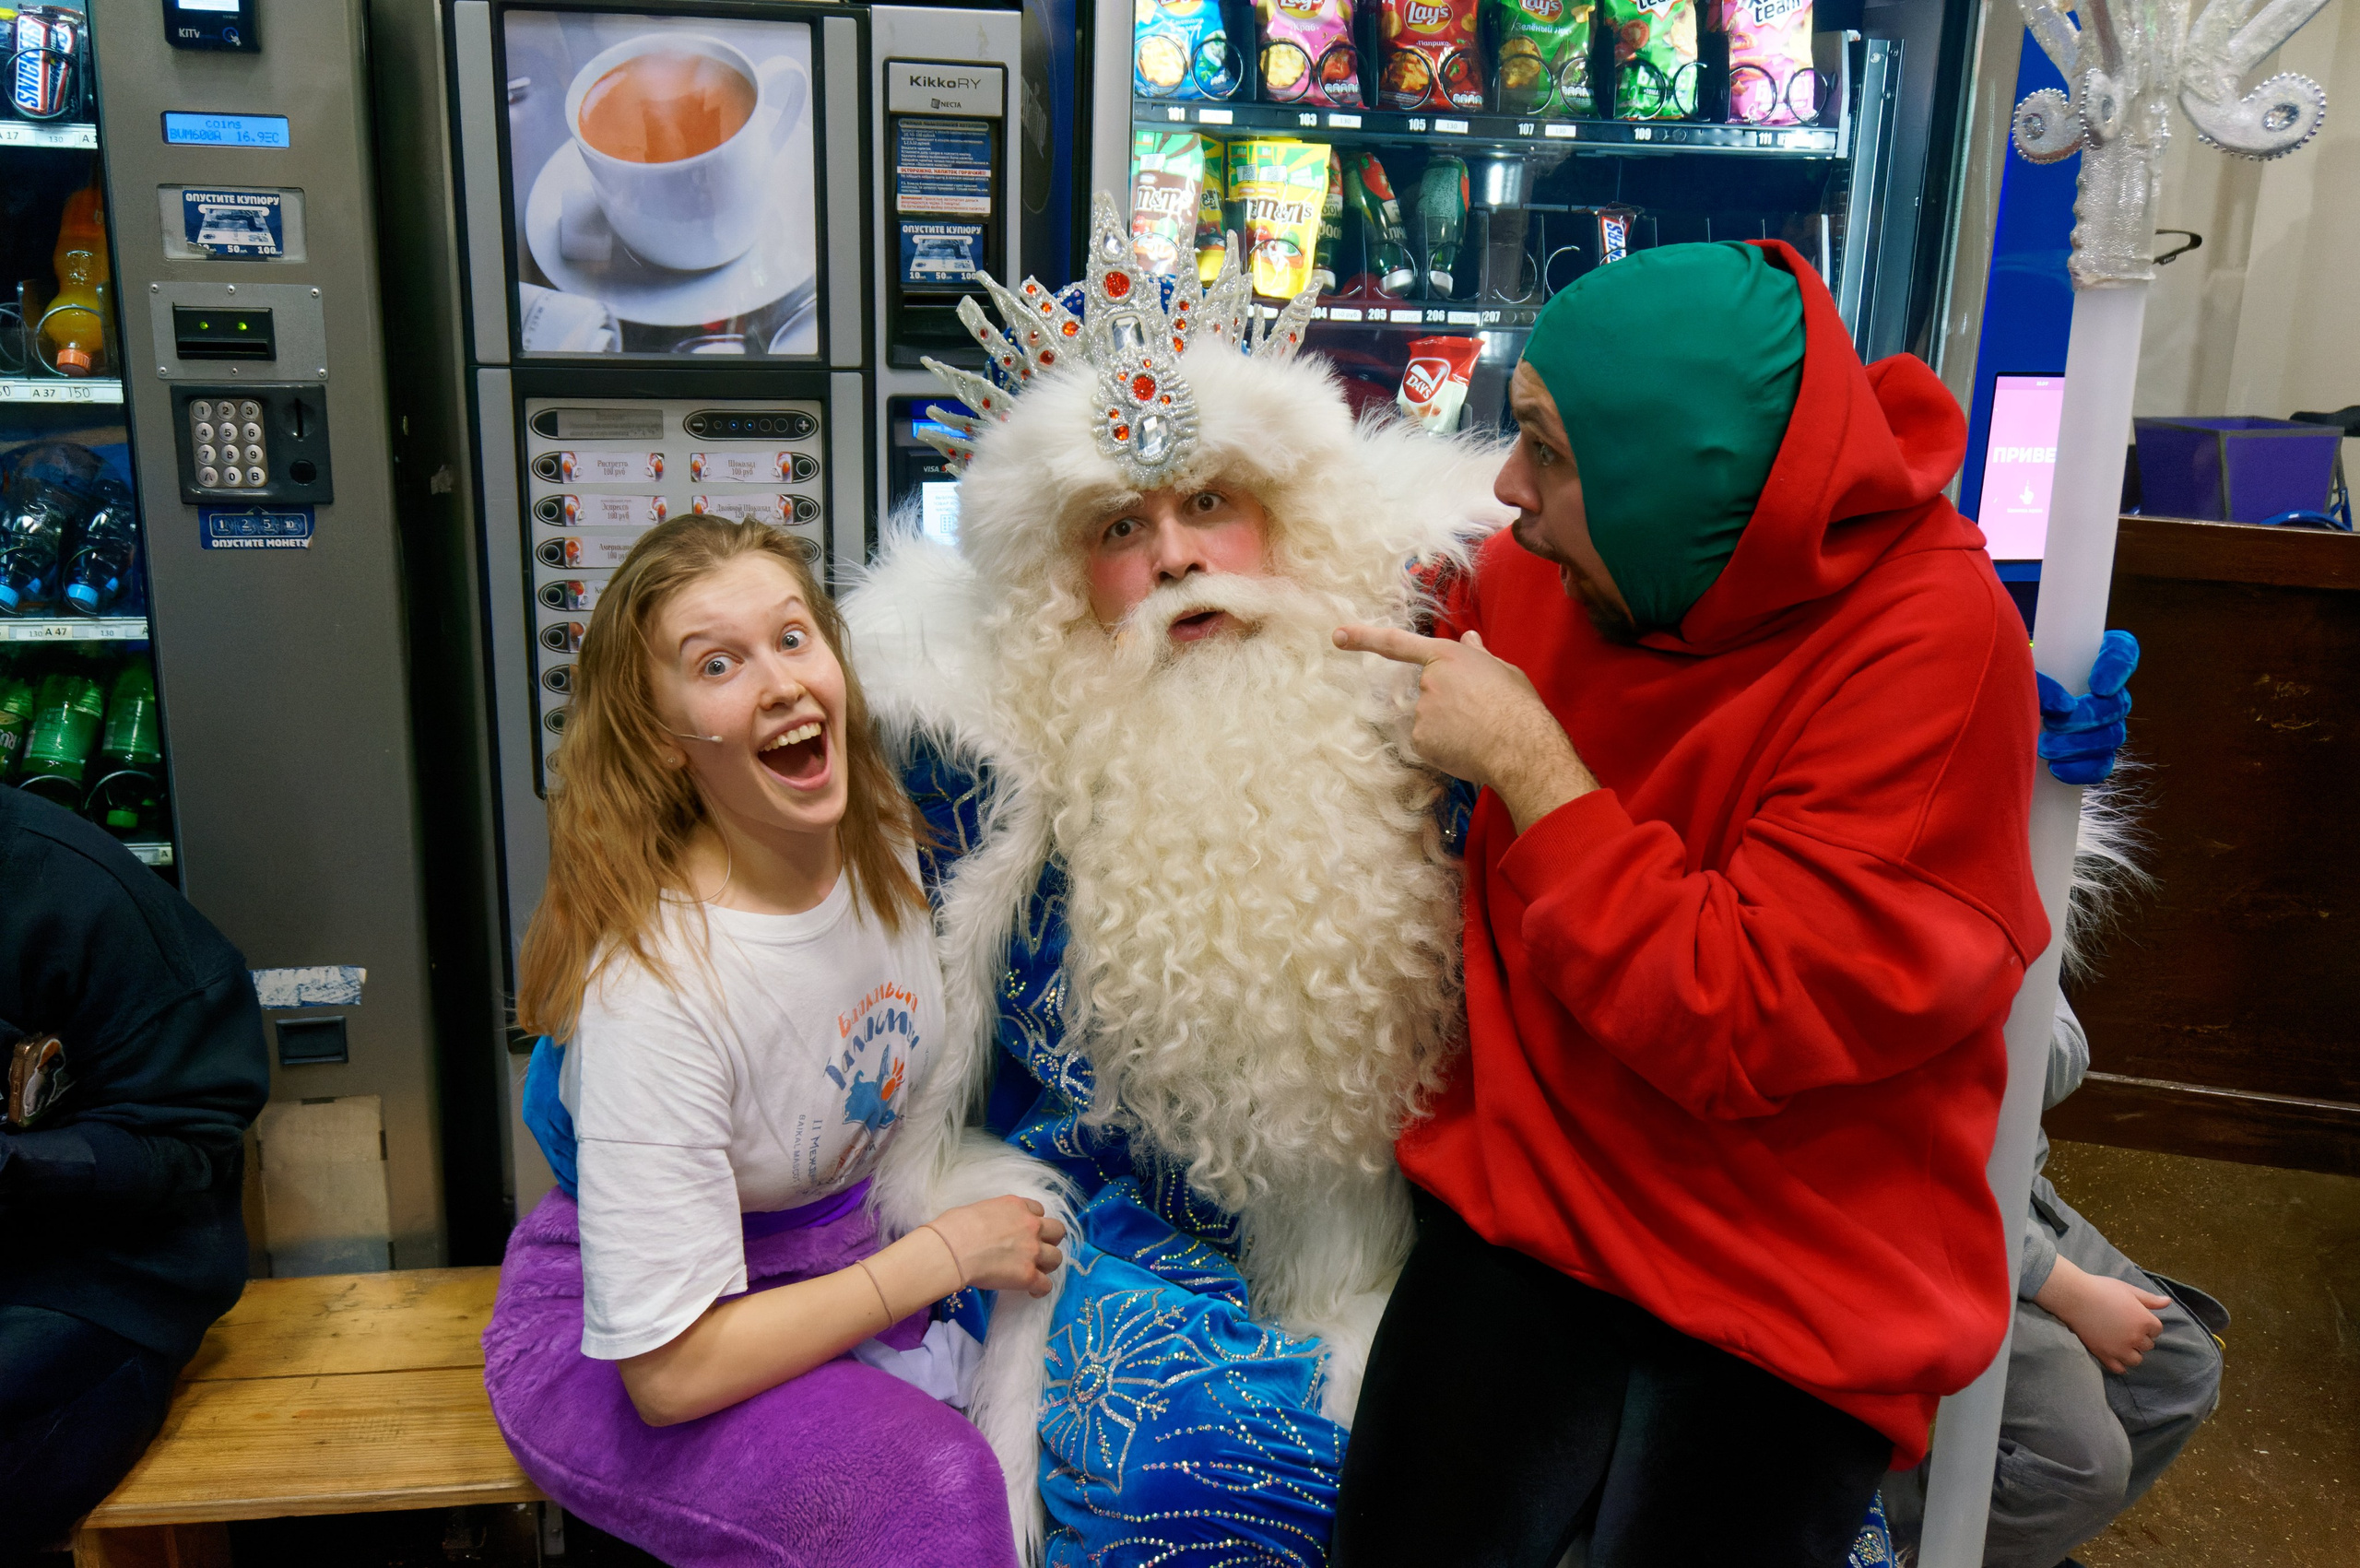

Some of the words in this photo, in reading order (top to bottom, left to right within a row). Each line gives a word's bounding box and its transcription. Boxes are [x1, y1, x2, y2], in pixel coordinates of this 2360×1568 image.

[1408, 1, 1448, 25] Lay's
[18, 19, 41, 108] SNICKERS
[910, 75, 982, 89] KikkoRY
[1167, 107, 1186, 121] 101
[1299, 113, 1316, 126] 103
[205, 121, 242, 129] coins
[1409, 119, 1426, 132] 105
[1518, 123, 1534, 136] 107
[1634, 127, 1651, 140] 109
[1758, 133, 1772, 145] 111
[185, 193, 235, 204] ОПУСТИТЕ
[237, 196, 280, 206] КУПЮРУ
[903, 225, 945, 234] ОПУСТИТЕ
[946, 226, 982, 234] КУПЮРУ
[227, 245, 241, 253] 50
[257, 246, 277, 255] 100
[1310, 307, 1328, 319] 204
[1368, 309, 1386, 320] 205
[1426, 310, 1445, 322] 206
[1484, 311, 1500, 322] 207
[68, 386, 90, 398] 150
[1406, 374, 1433, 399] DAYS
[32, 389, 40, 397] A
[43, 389, 55, 397] 37
[200, 407, 206, 415] 1
[222, 407, 229, 415] 2
[246, 407, 253, 415] 3
[201, 429, 207, 437] 4
[224, 429, 231, 437] 5
[248, 429, 254, 437] 6
[203, 451, 209, 459] 7
[227, 451, 233, 459] 8
[250, 451, 256, 459] 9
[1992, 447, 2058, 463] ПРИВЕ
[727, 459, 755, 468] Шоколад
[204, 472, 213, 481] A
[229, 472, 235, 481] 0
[252, 472, 259, 481] B
[744, 504, 771, 513] Шоколад
[242, 519, 249, 528] 2
[264, 519, 271, 529] 5
[212, 538, 265, 548] ОПУСТИТЕ
[266, 538, 309, 548] МОНЕТУ
[55, 628, 67, 636] 47
[793, 1114, 806, 1149] BAIKAL
